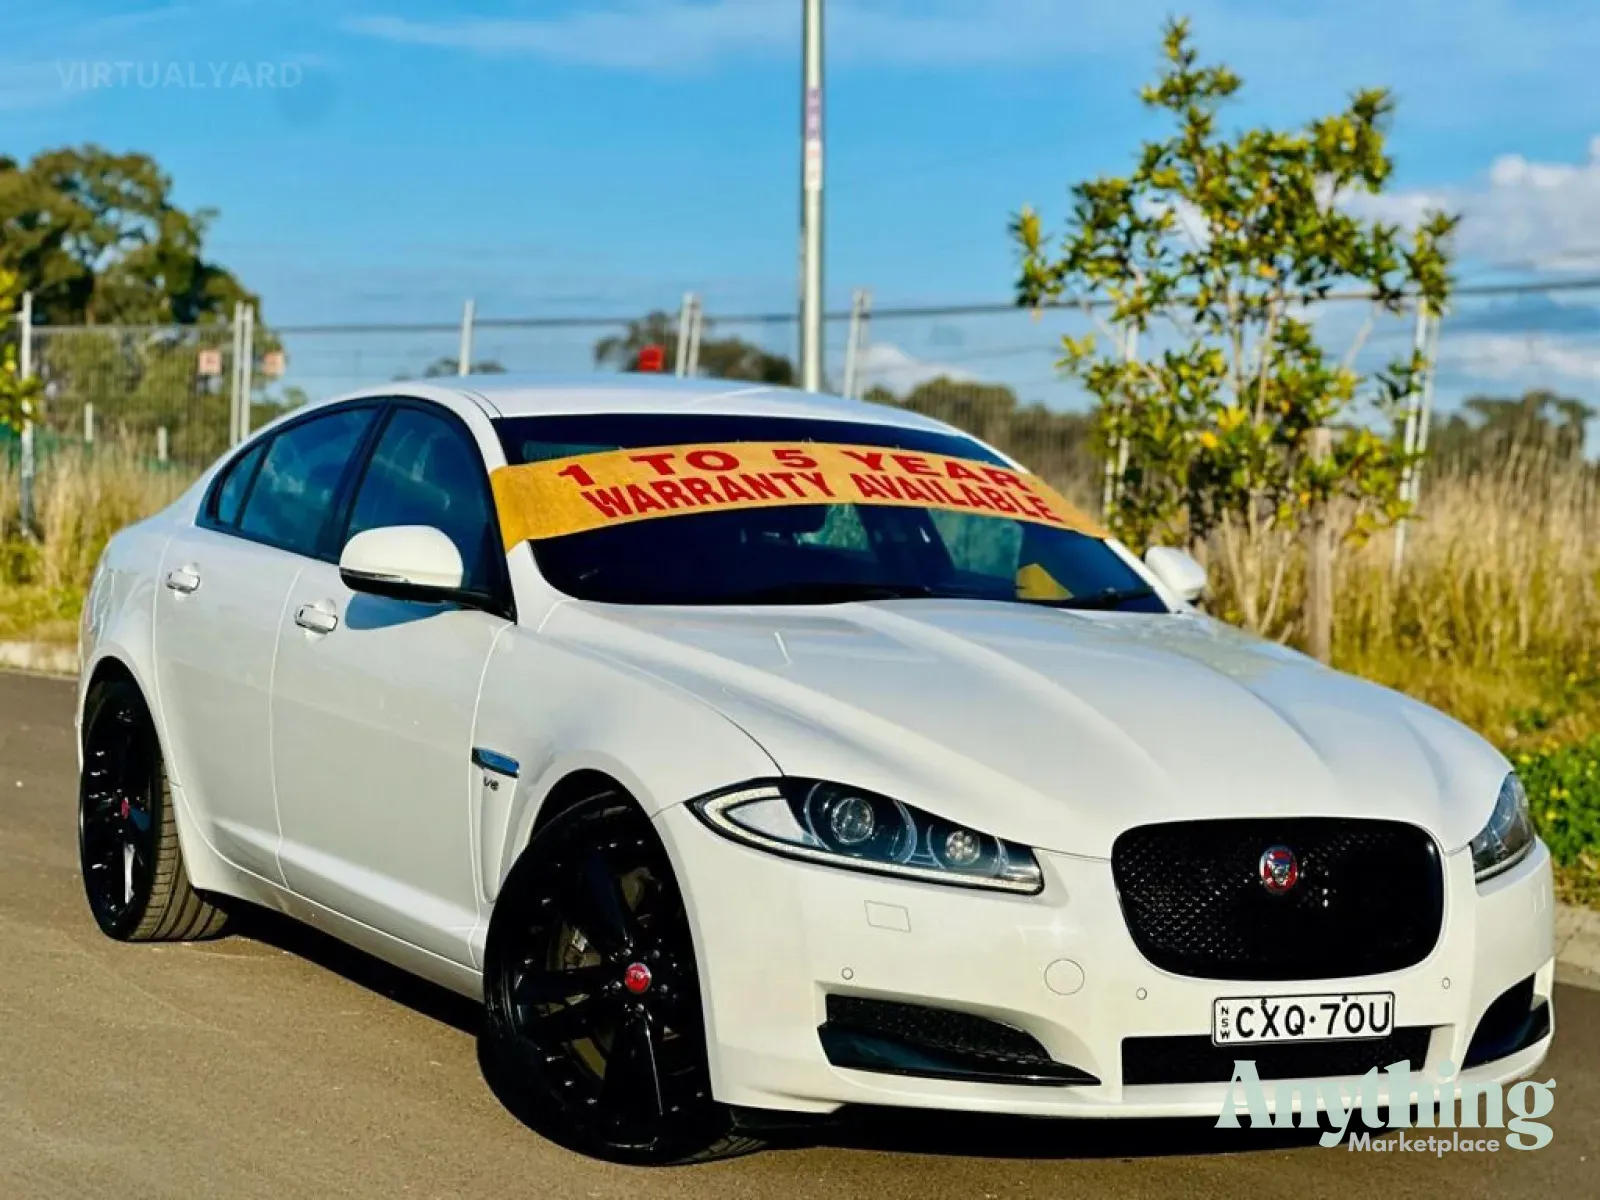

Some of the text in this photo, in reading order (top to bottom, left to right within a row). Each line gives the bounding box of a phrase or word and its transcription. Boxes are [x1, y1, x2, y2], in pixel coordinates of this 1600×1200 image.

[558, 449, 1032, 493] 1 TO 5 YEAR
[580, 471, 1065, 523] WARRANTY AVAILABLE
[1219, 1005, 1231, 1040] NSW
